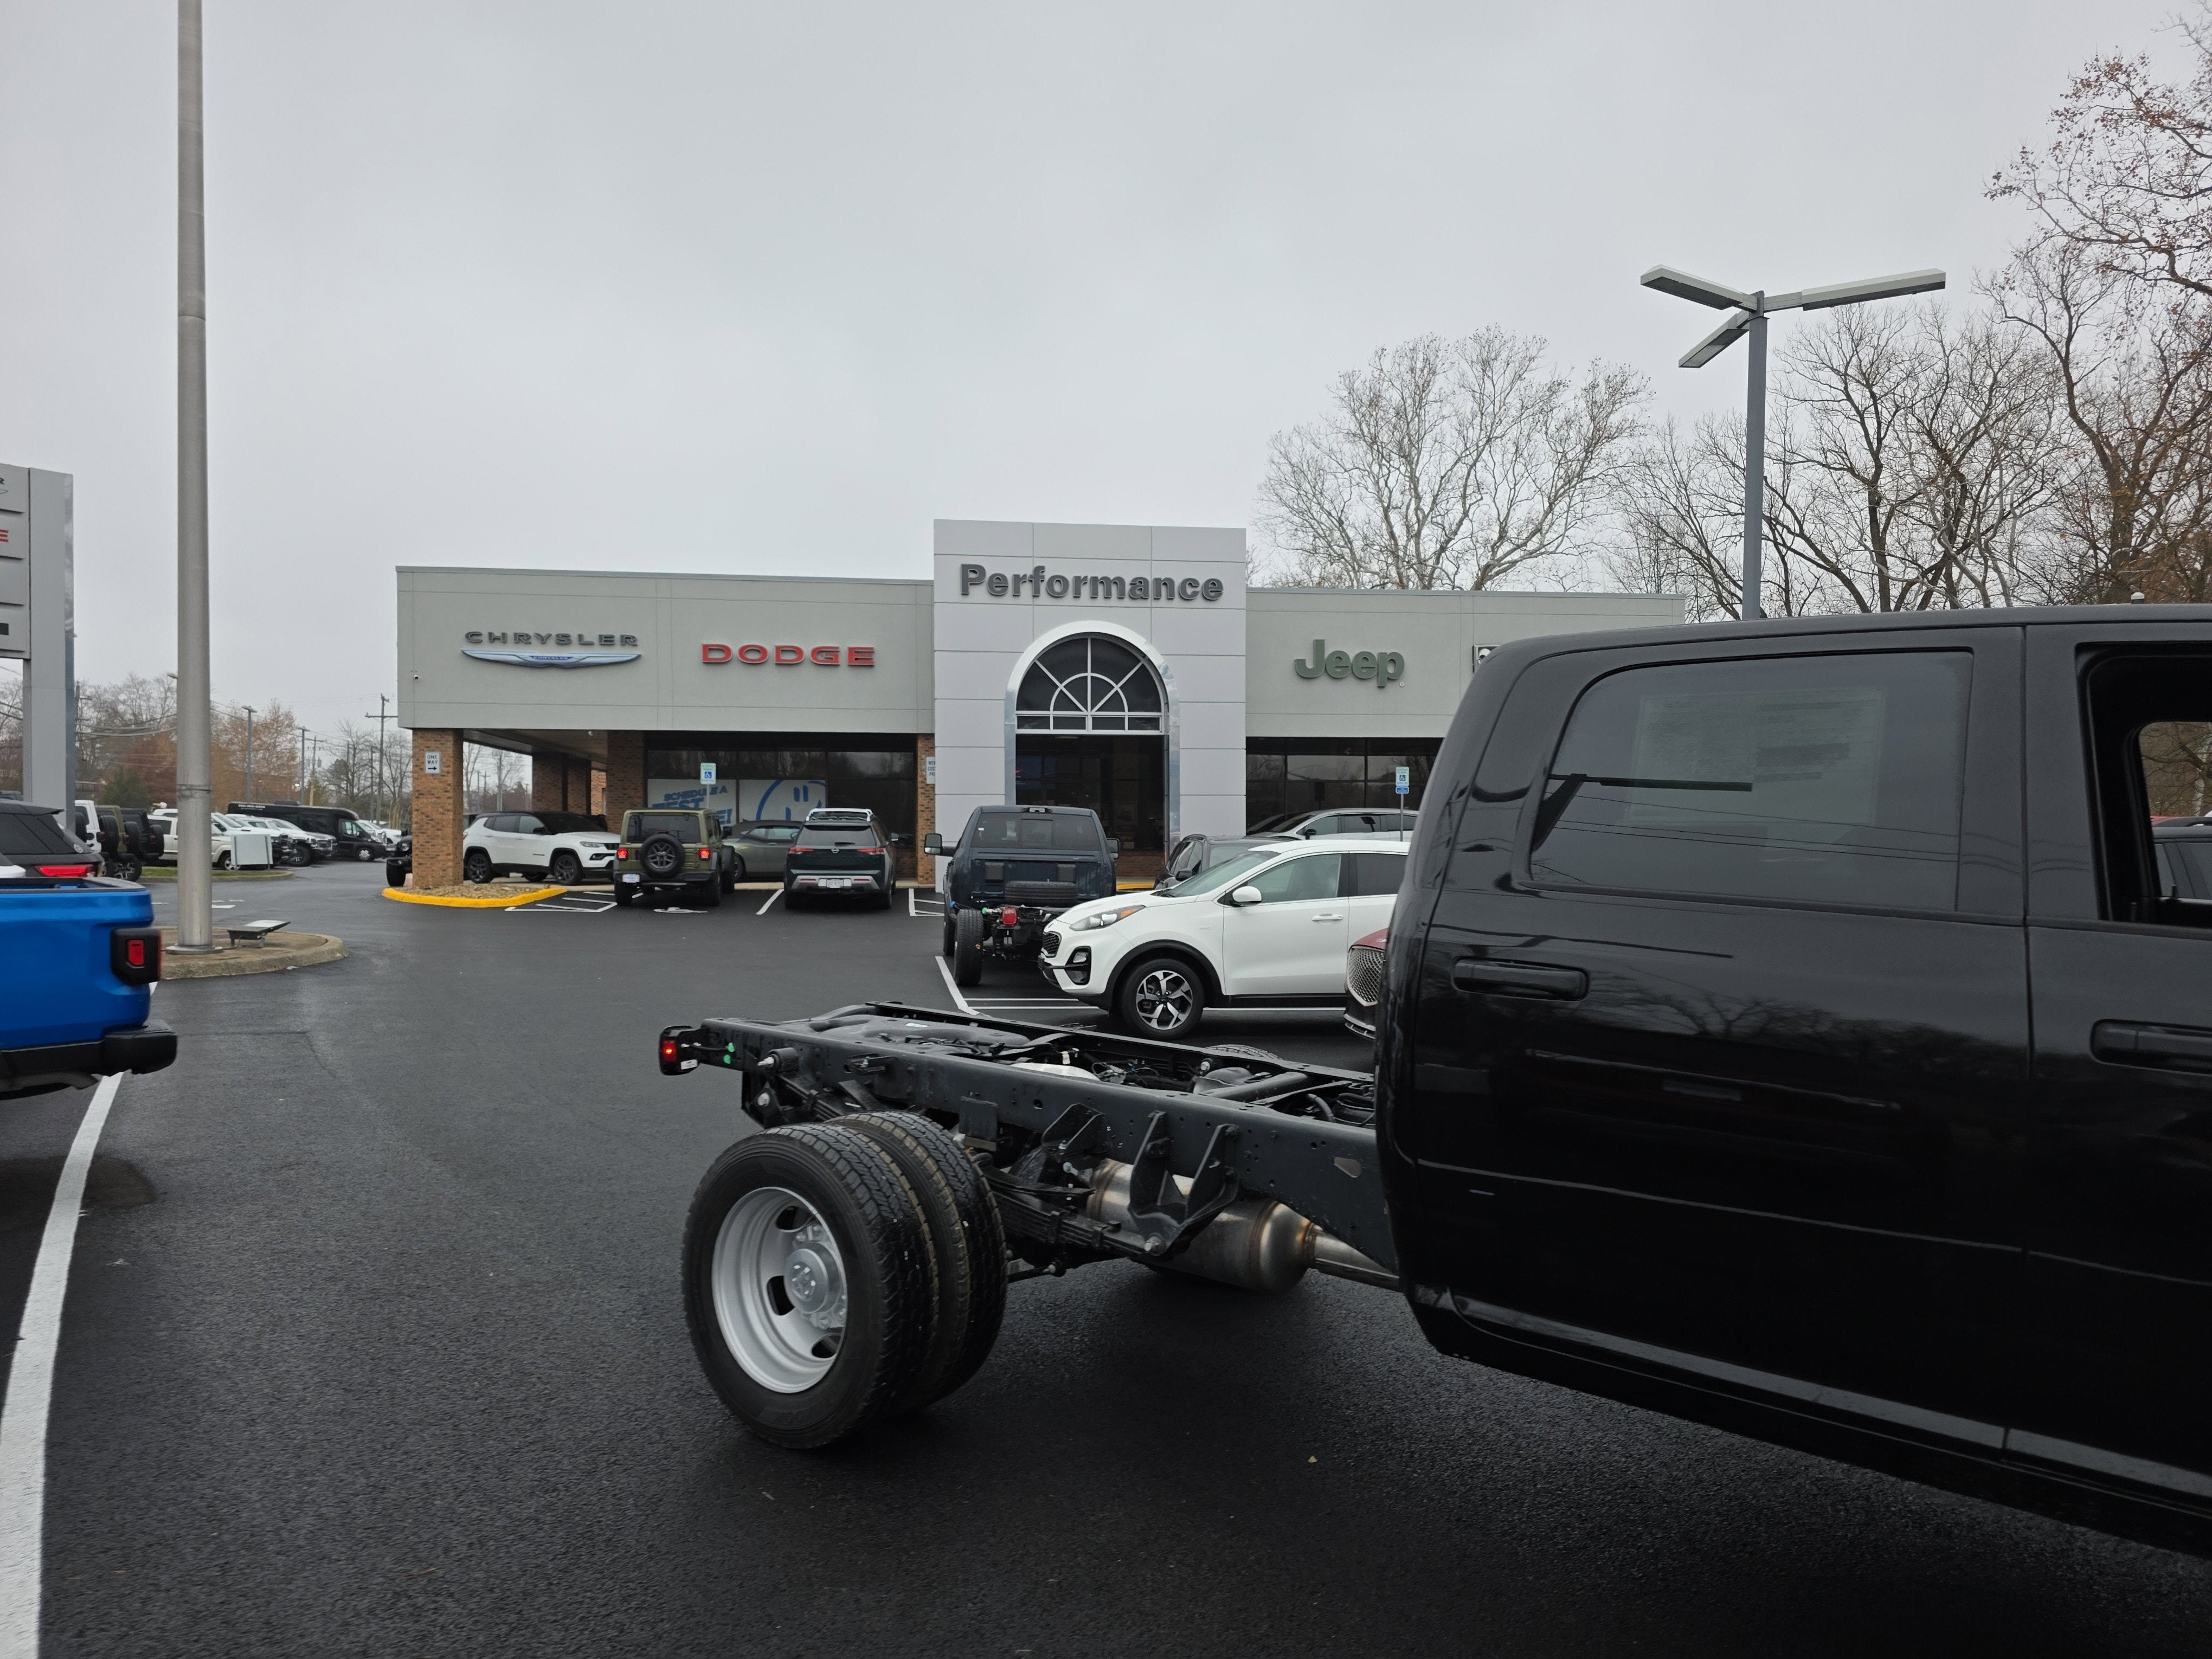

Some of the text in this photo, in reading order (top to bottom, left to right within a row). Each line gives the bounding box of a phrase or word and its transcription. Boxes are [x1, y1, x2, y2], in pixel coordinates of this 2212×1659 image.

[961, 563, 1224, 600] Performance
[465, 631, 638, 646] CHRYSLER
[702, 644, 875, 666] DODGE
[1295, 639, 1405, 688] Jeep
[719, 785, 728, 794] A
[652, 797, 705, 808] ST
